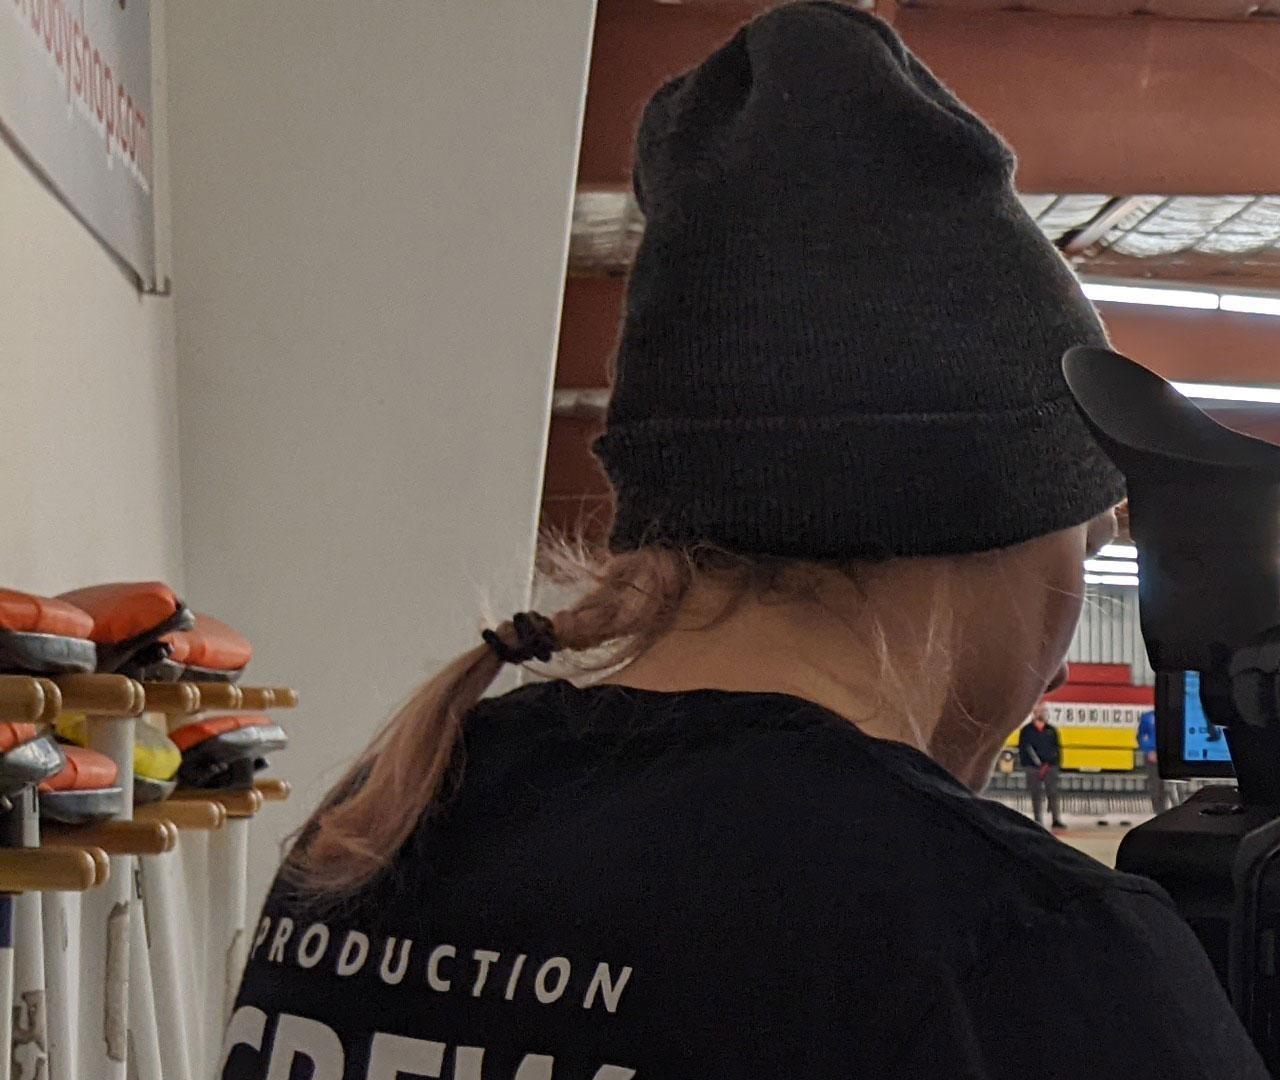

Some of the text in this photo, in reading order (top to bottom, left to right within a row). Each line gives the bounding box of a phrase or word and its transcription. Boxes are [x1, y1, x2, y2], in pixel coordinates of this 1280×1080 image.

[1054, 708, 1062, 721] 7
[1066, 709, 1074, 722] 8
[1078, 709, 1086, 722] 9
[1102, 709, 1109, 722] 11
[250, 916, 633, 1013] PRODUCTION
